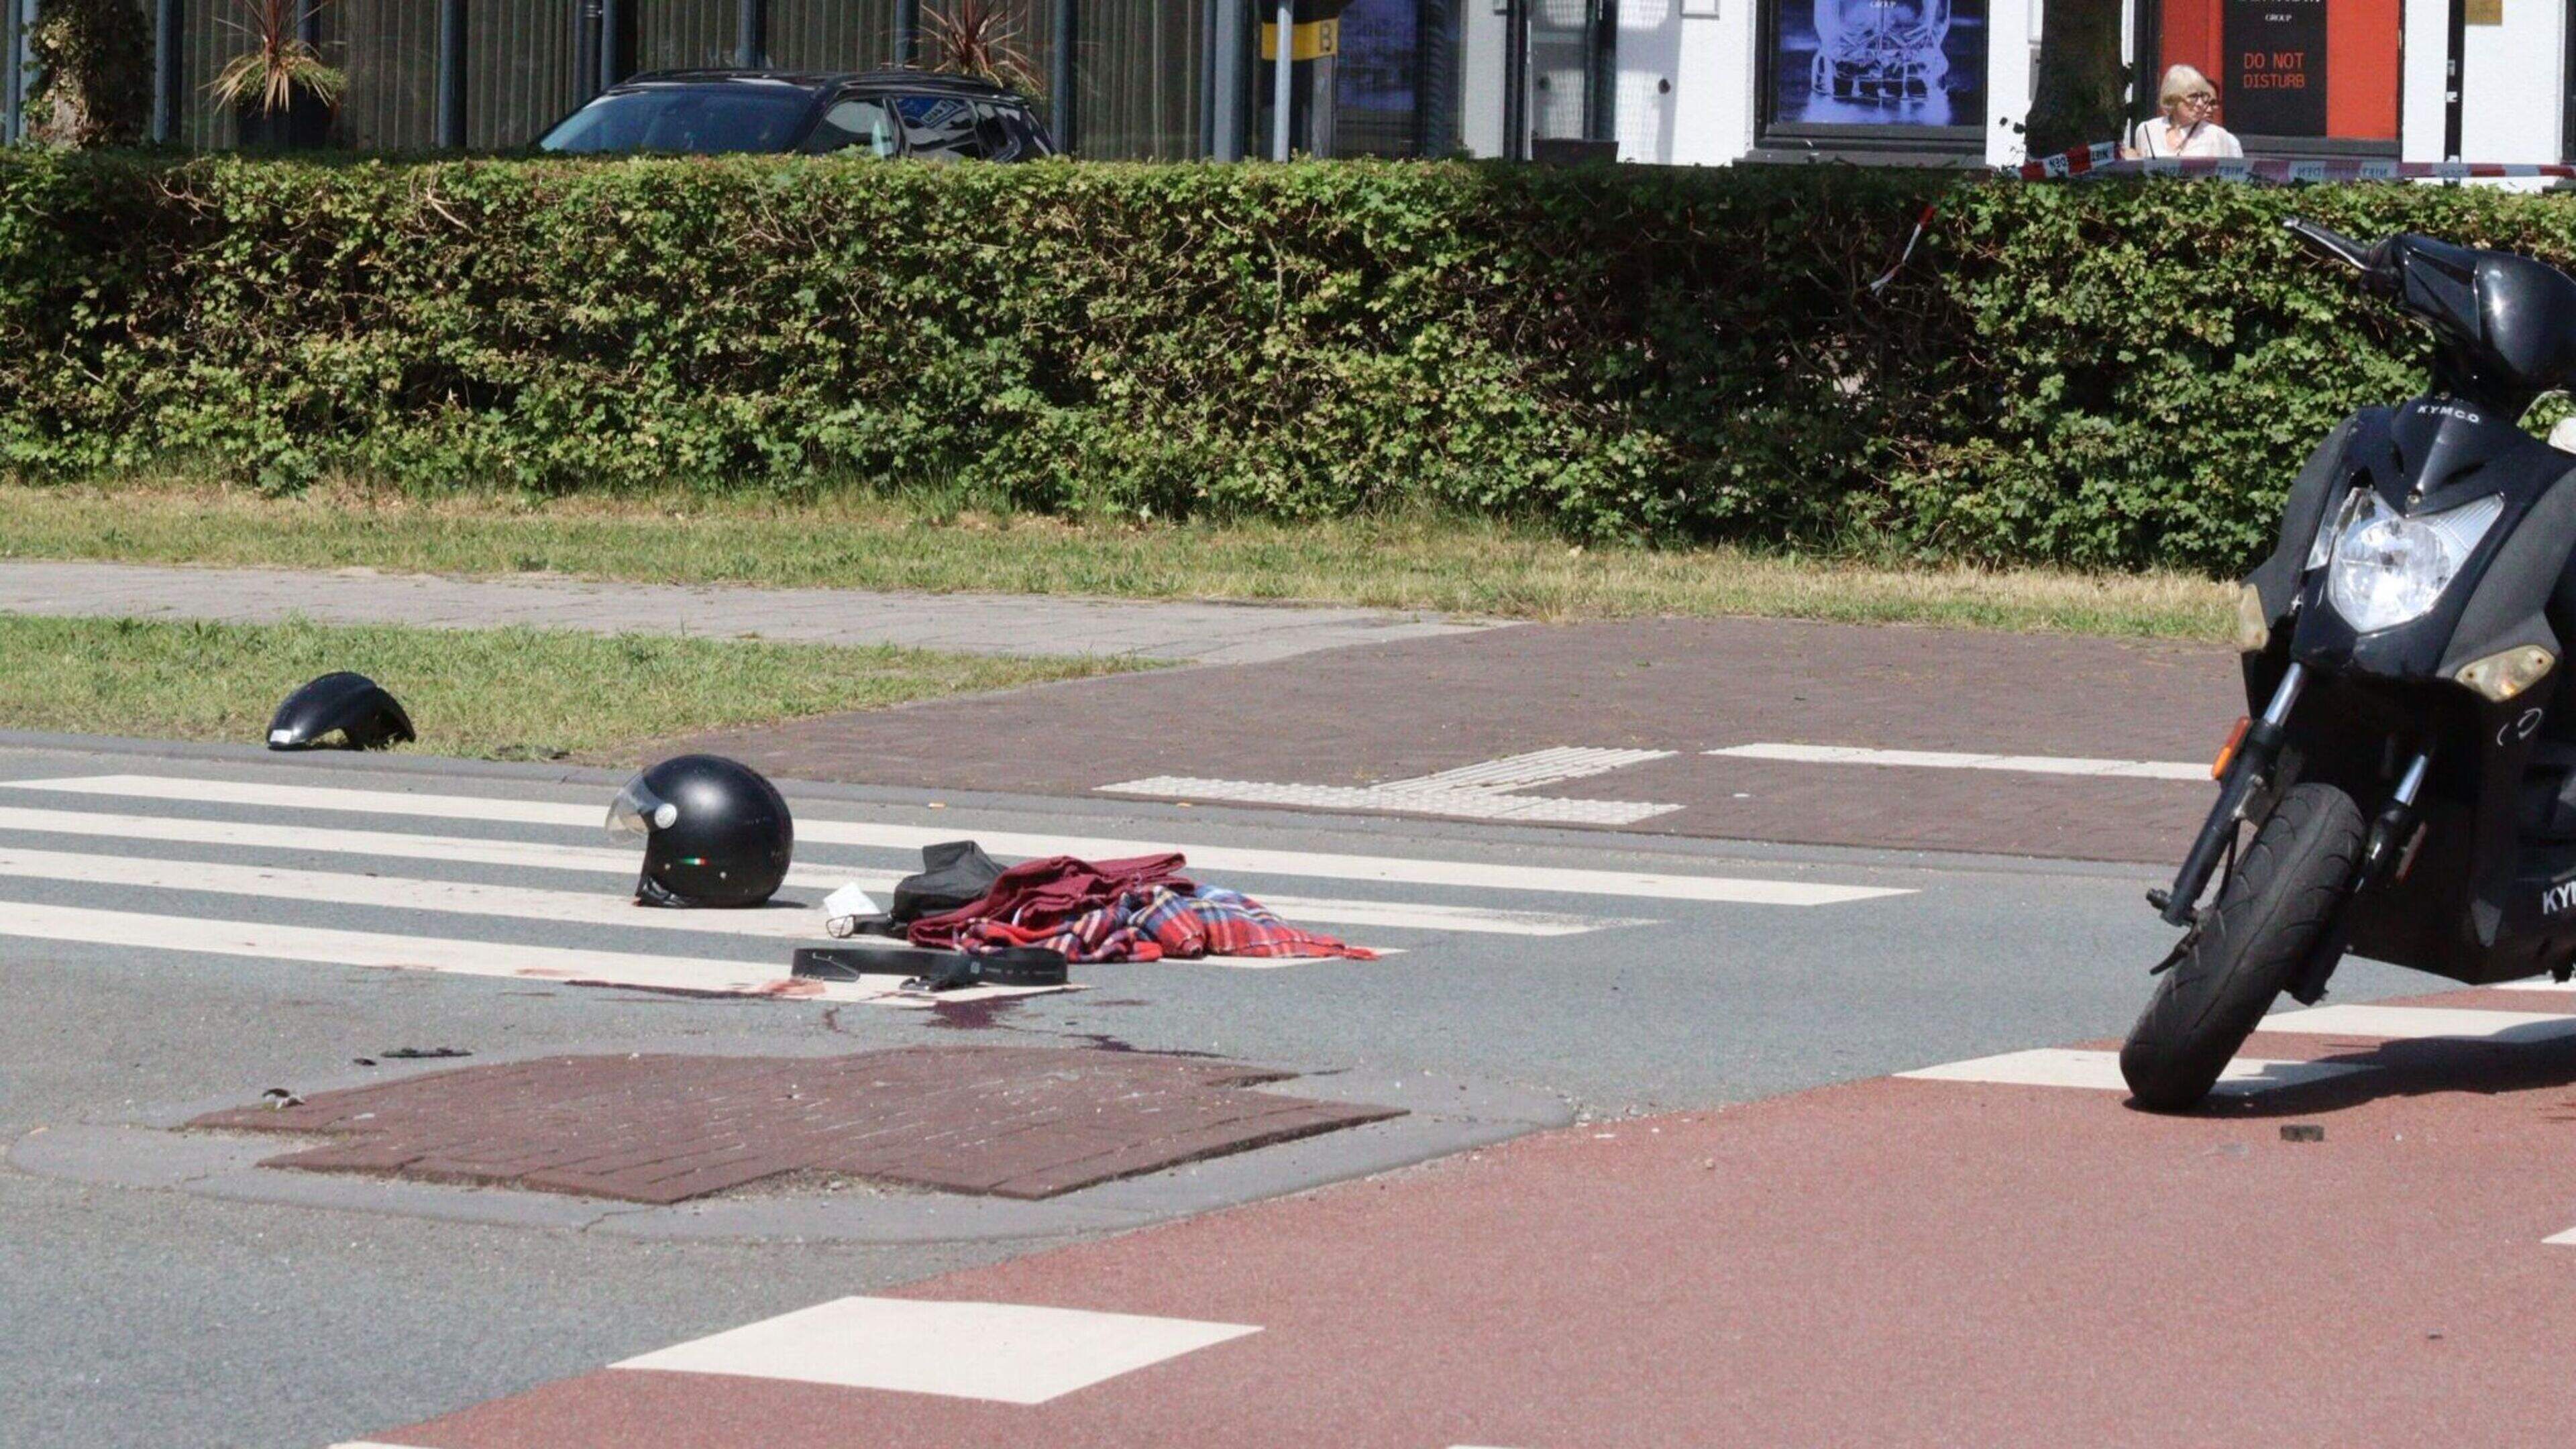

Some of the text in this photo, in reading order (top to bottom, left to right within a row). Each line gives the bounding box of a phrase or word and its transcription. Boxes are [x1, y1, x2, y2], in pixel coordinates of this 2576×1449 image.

[2244, 52, 2304, 68] DO NOT
[2243, 74, 2305, 89] DISTURB
[2417, 405, 2480, 423] KYMCO
